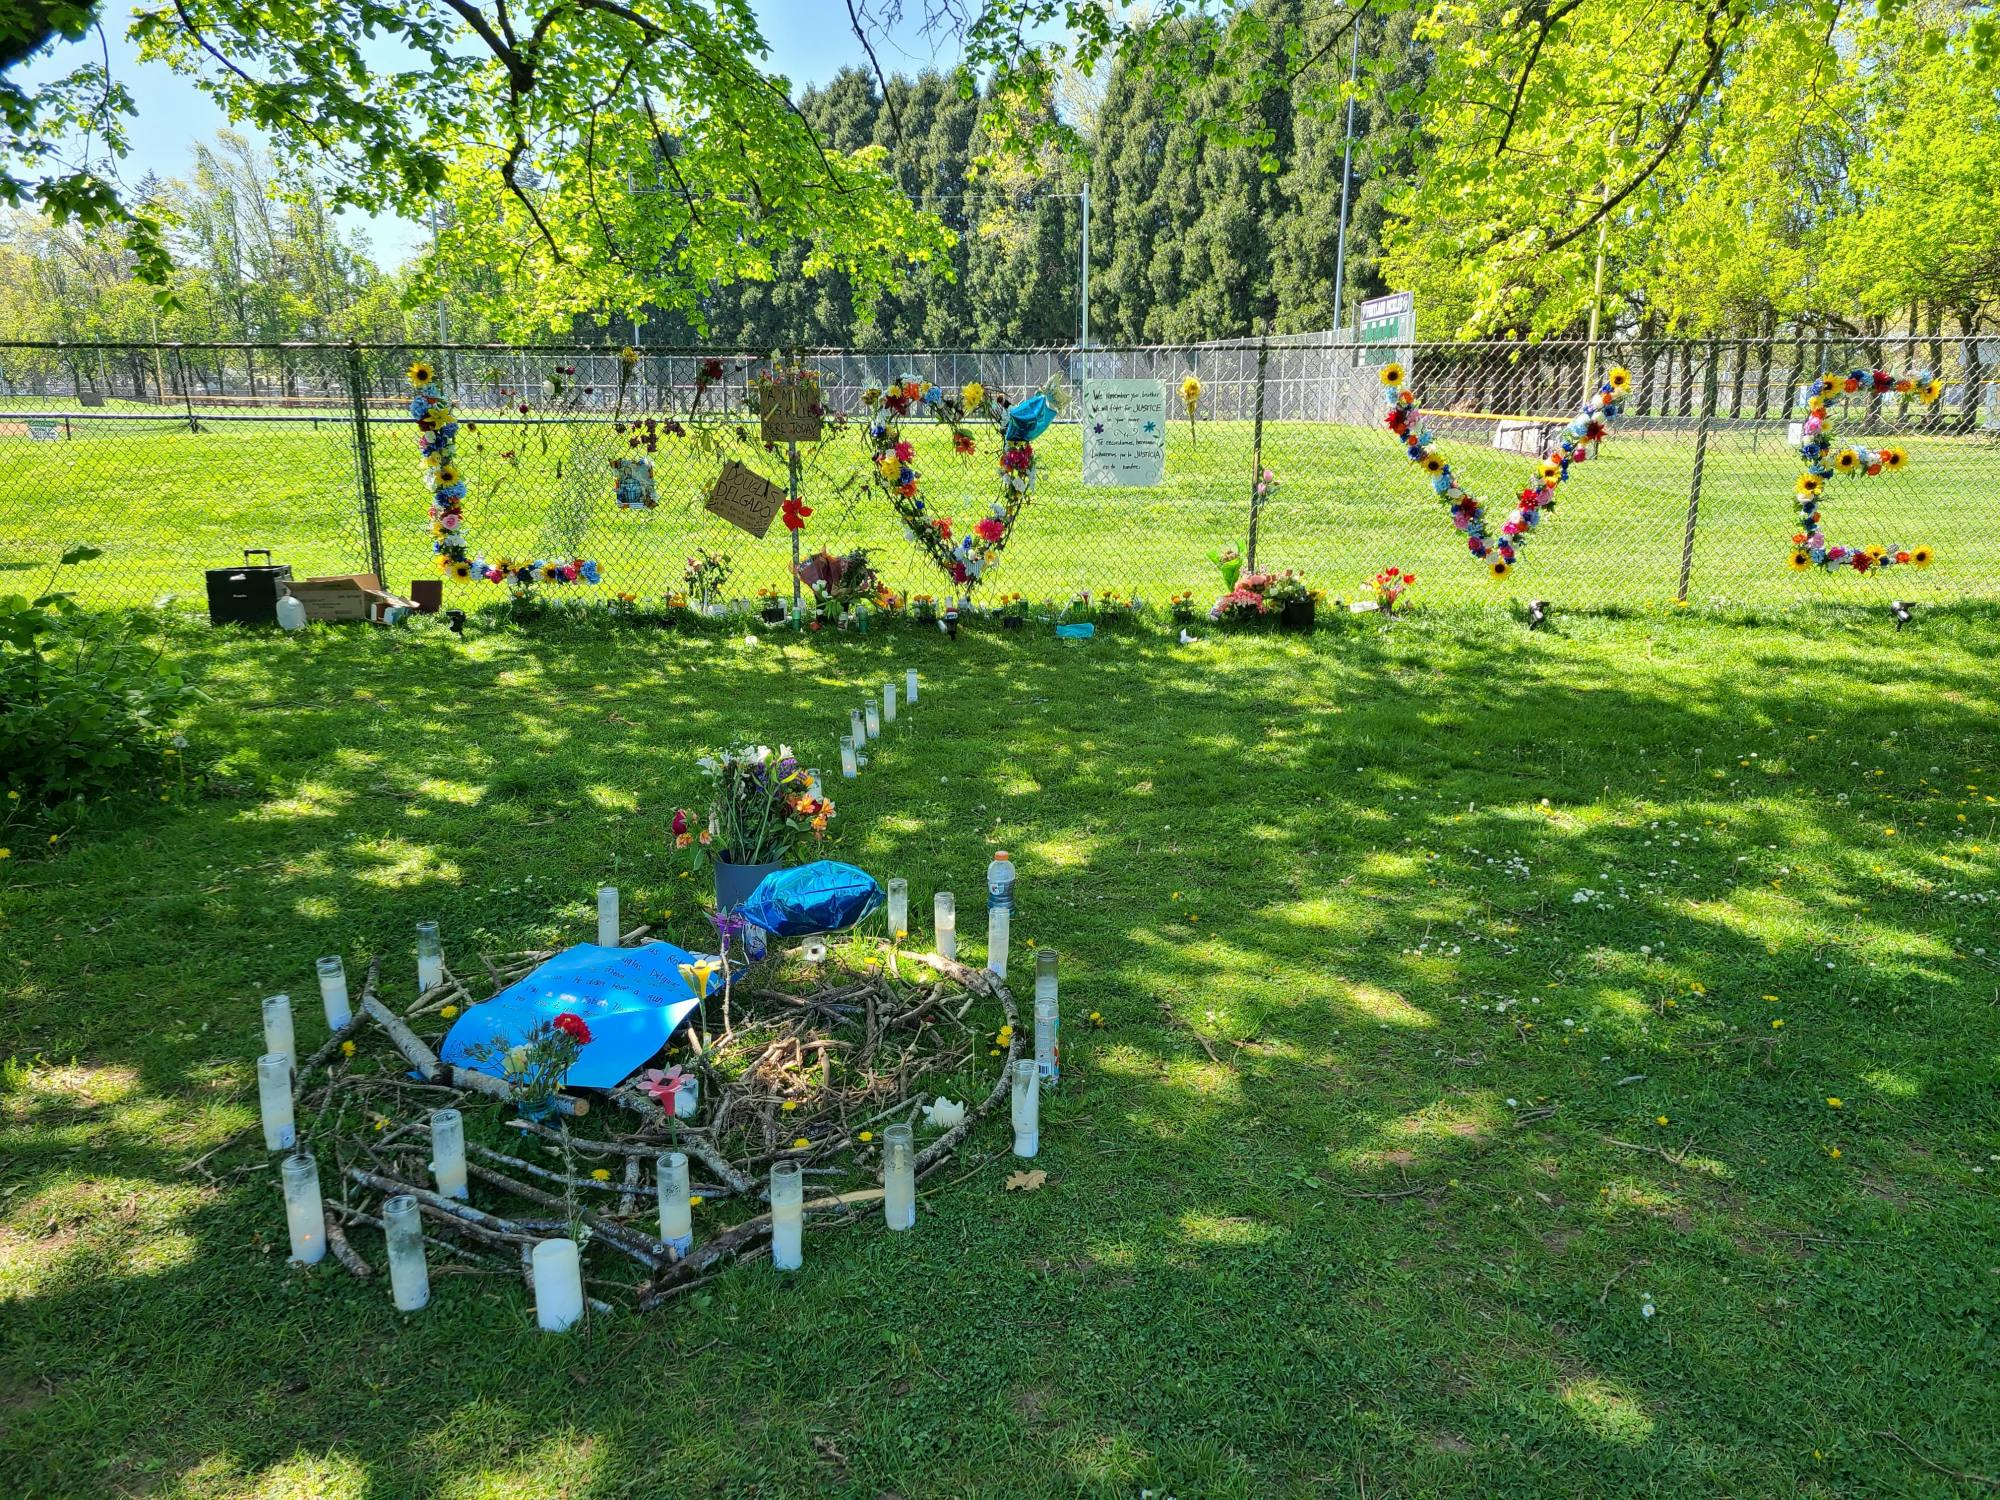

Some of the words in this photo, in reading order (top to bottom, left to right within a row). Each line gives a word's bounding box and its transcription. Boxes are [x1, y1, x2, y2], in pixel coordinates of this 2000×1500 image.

[1133, 403, 1162, 413] JUSTICE
[1134, 449, 1161, 459] JUSTICIA
[717, 482, 771, 518] DELGADO
